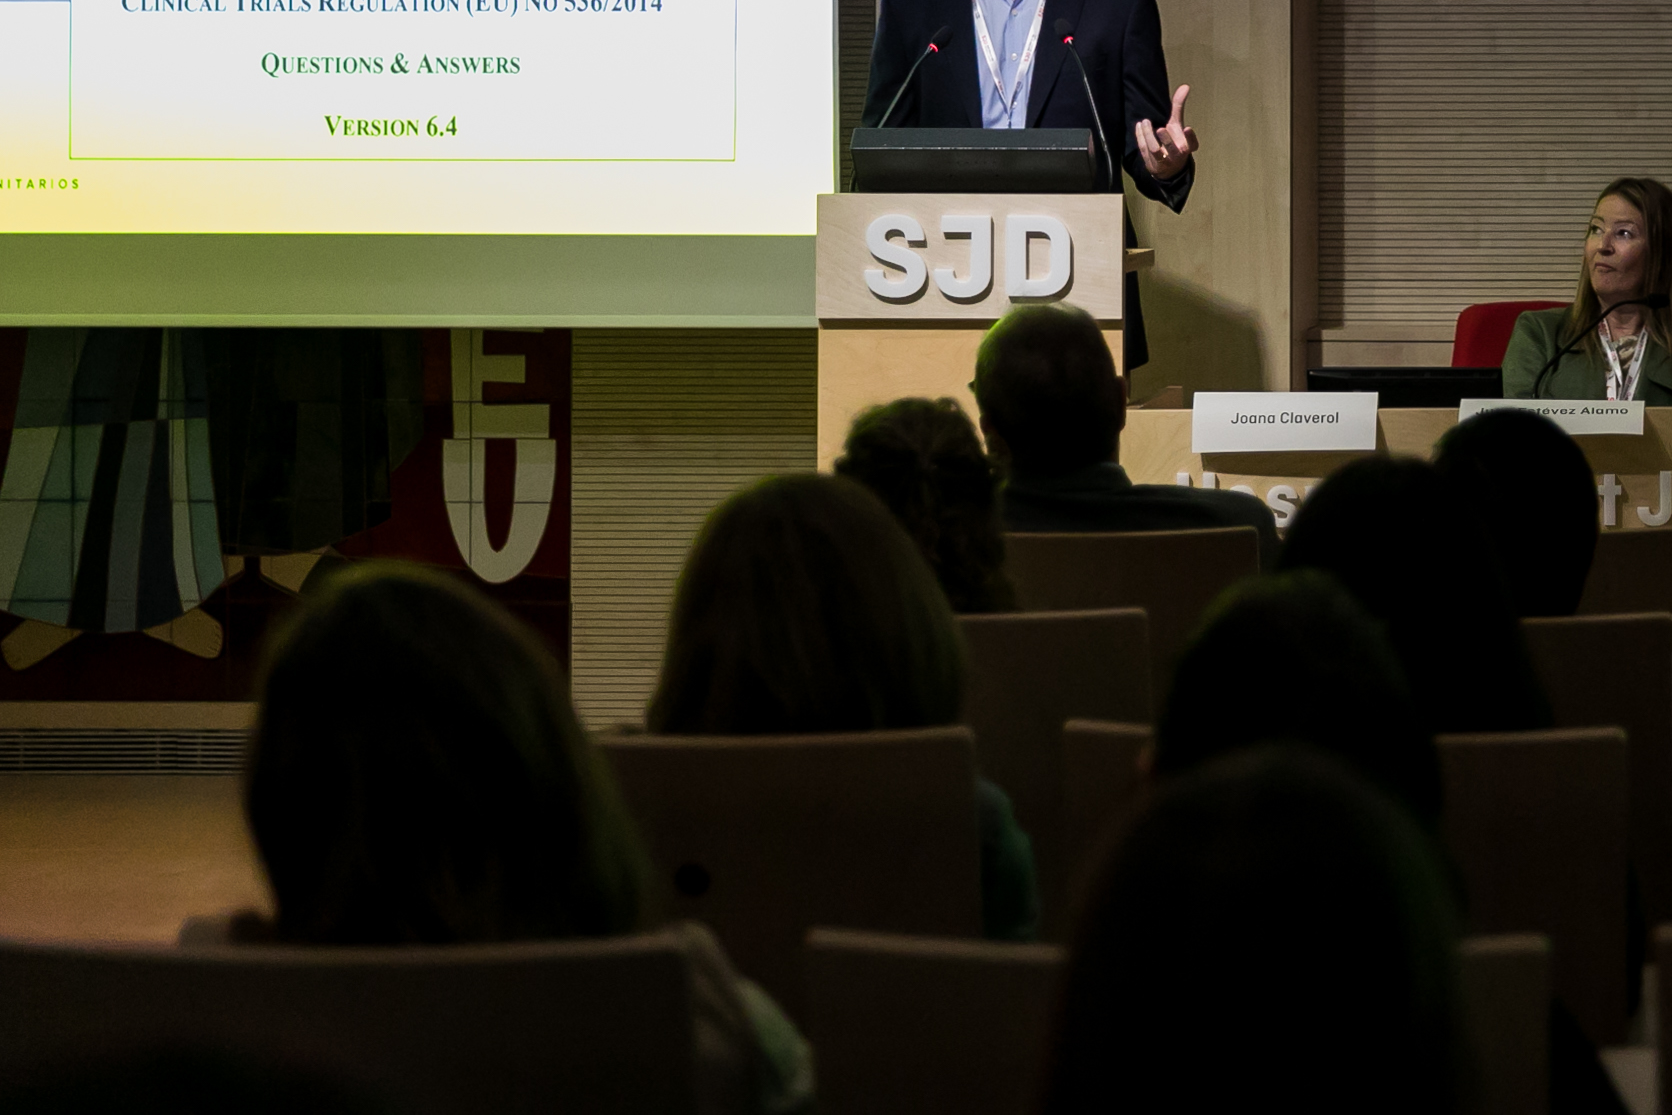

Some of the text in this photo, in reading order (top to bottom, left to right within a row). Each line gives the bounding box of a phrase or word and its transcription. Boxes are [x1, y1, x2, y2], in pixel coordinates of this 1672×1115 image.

[390, 52, 410, 75] &
[426, 115, 458, 137] 6.4
[864, 213, 1072, 299] SJD
[1230, 411, 1340, 425] Joana Claverol
